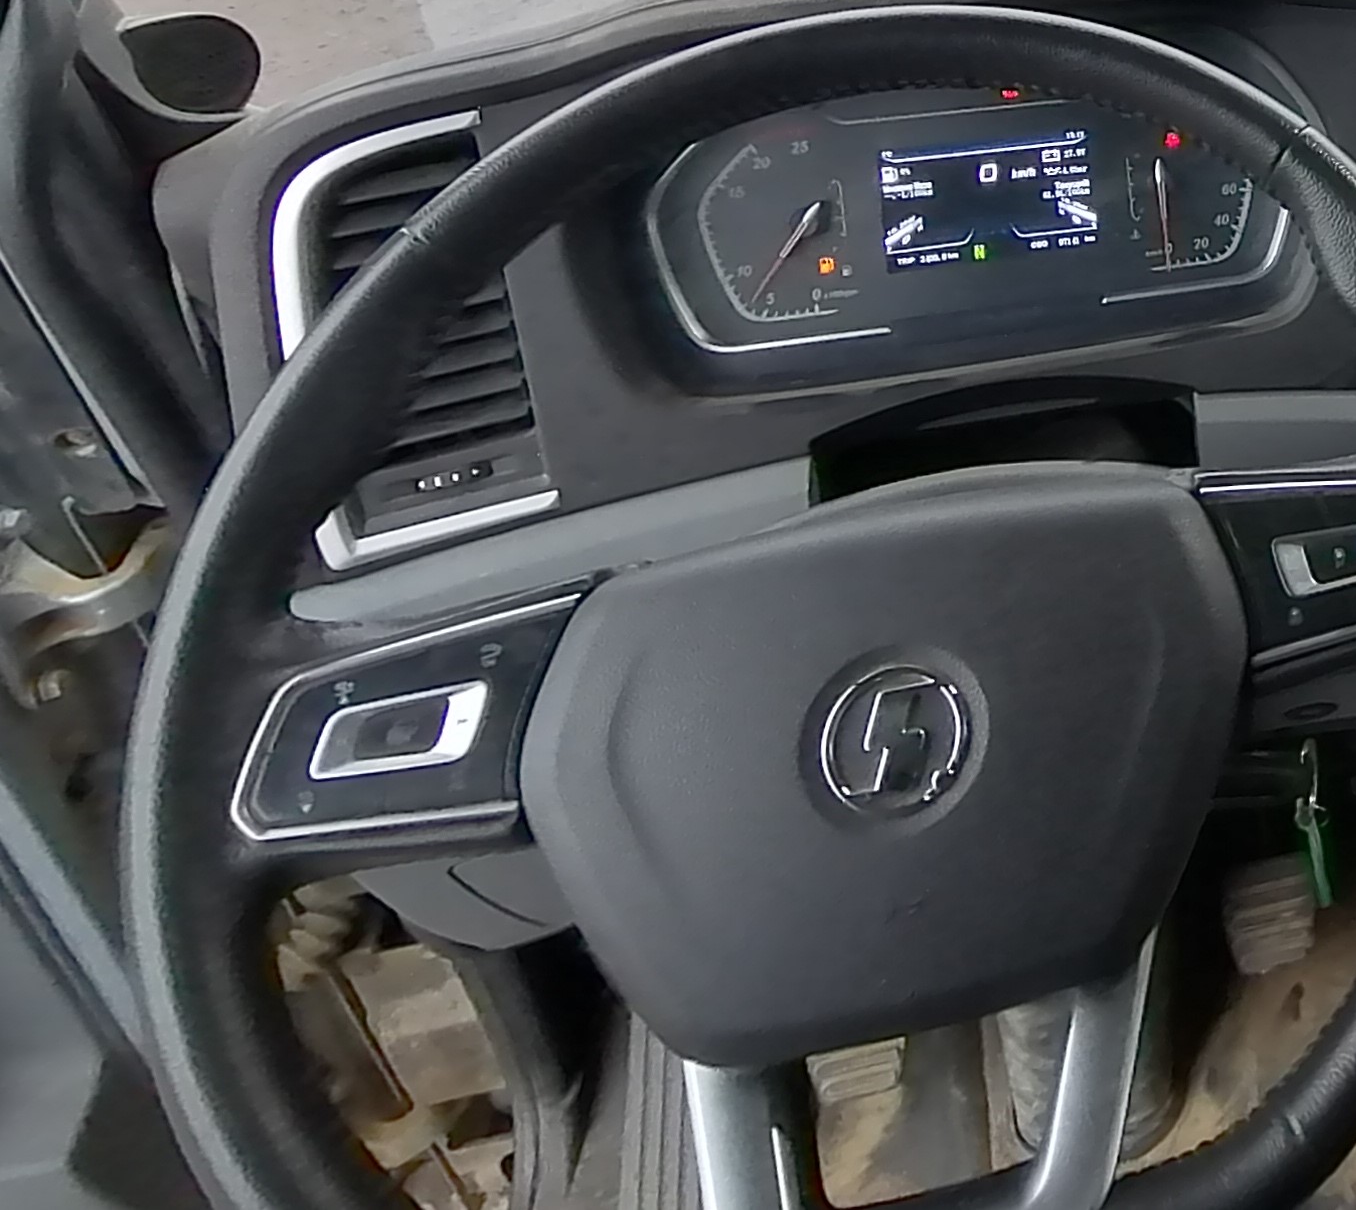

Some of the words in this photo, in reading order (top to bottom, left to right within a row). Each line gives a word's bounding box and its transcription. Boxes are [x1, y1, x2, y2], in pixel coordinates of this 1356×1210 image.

[791, 140, 809, 155] 25
[752, 156, 771, 169] 20
[979, 162, 998, 183] 0
[1221, 184, 1236, 195] 60
[1214, 214, 1230, 226] 40
[1194, 237, 1210, 249] 20
[973, 243, 986, 260] N
[737, 264, 752, 277] 10
[766, 291, 775, 305] 5
[811, 288, 822, 301] 0
